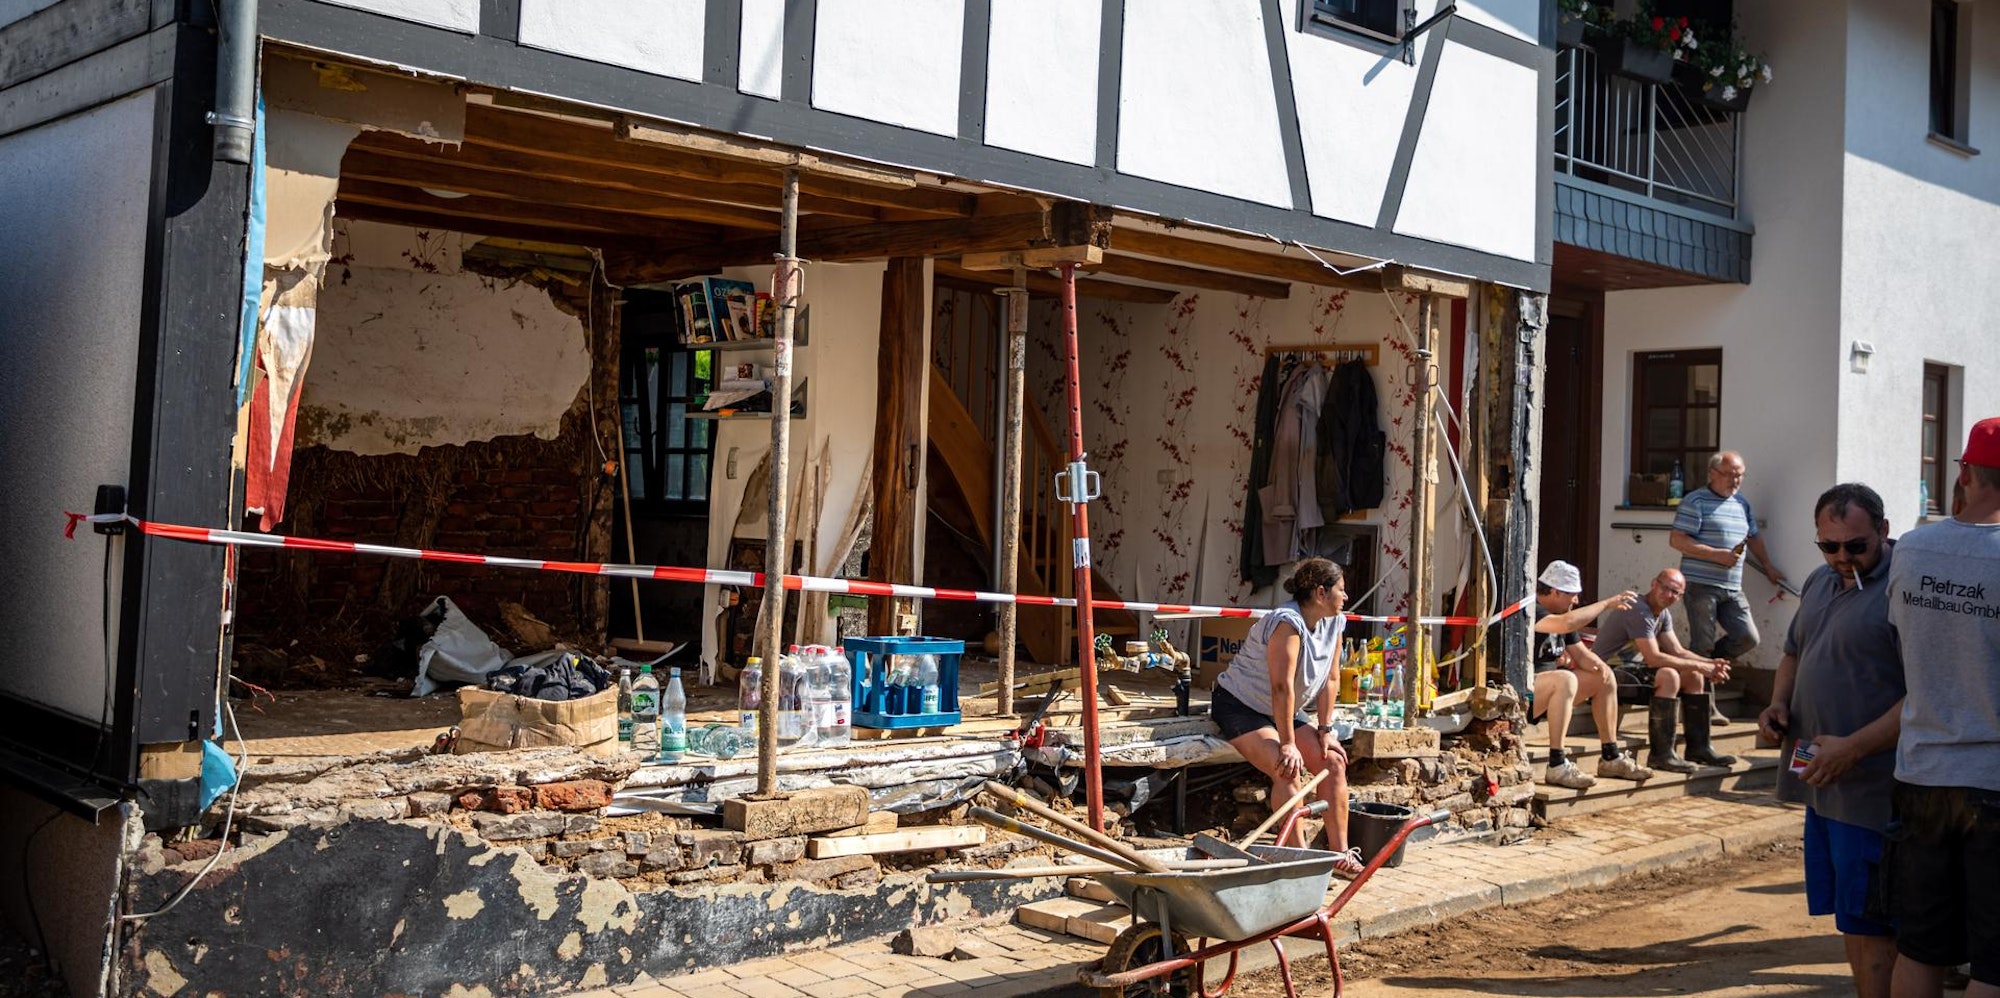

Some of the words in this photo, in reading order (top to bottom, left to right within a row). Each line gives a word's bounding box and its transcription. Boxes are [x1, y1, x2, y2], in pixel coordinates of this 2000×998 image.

[1920, 575, 1985, 600] Pietrzak
[1903, 591, 1960, 613] Metallbau
[1220, 637, 1245, 655] Nel
